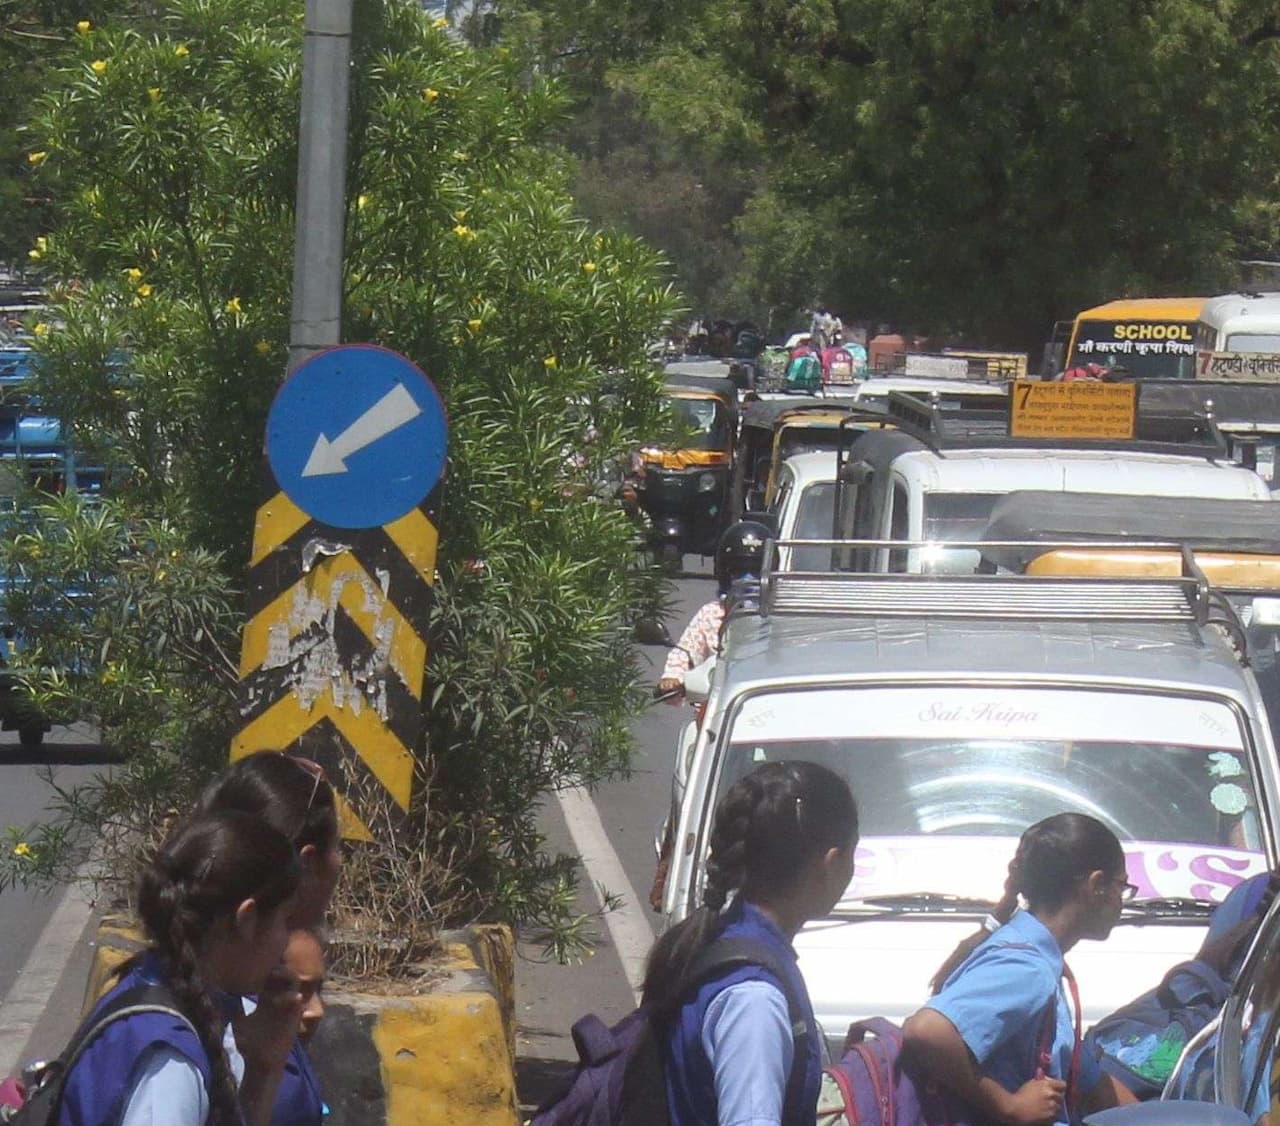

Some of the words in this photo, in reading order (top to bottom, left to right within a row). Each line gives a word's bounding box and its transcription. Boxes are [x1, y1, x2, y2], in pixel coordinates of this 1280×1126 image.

[1113, 324, 1193, 340] SCHOOL
[1199, 353, 1212, 375] 7
[1017, 383, 1033, 410] 7
[918, 701, 963, 722] Sai
